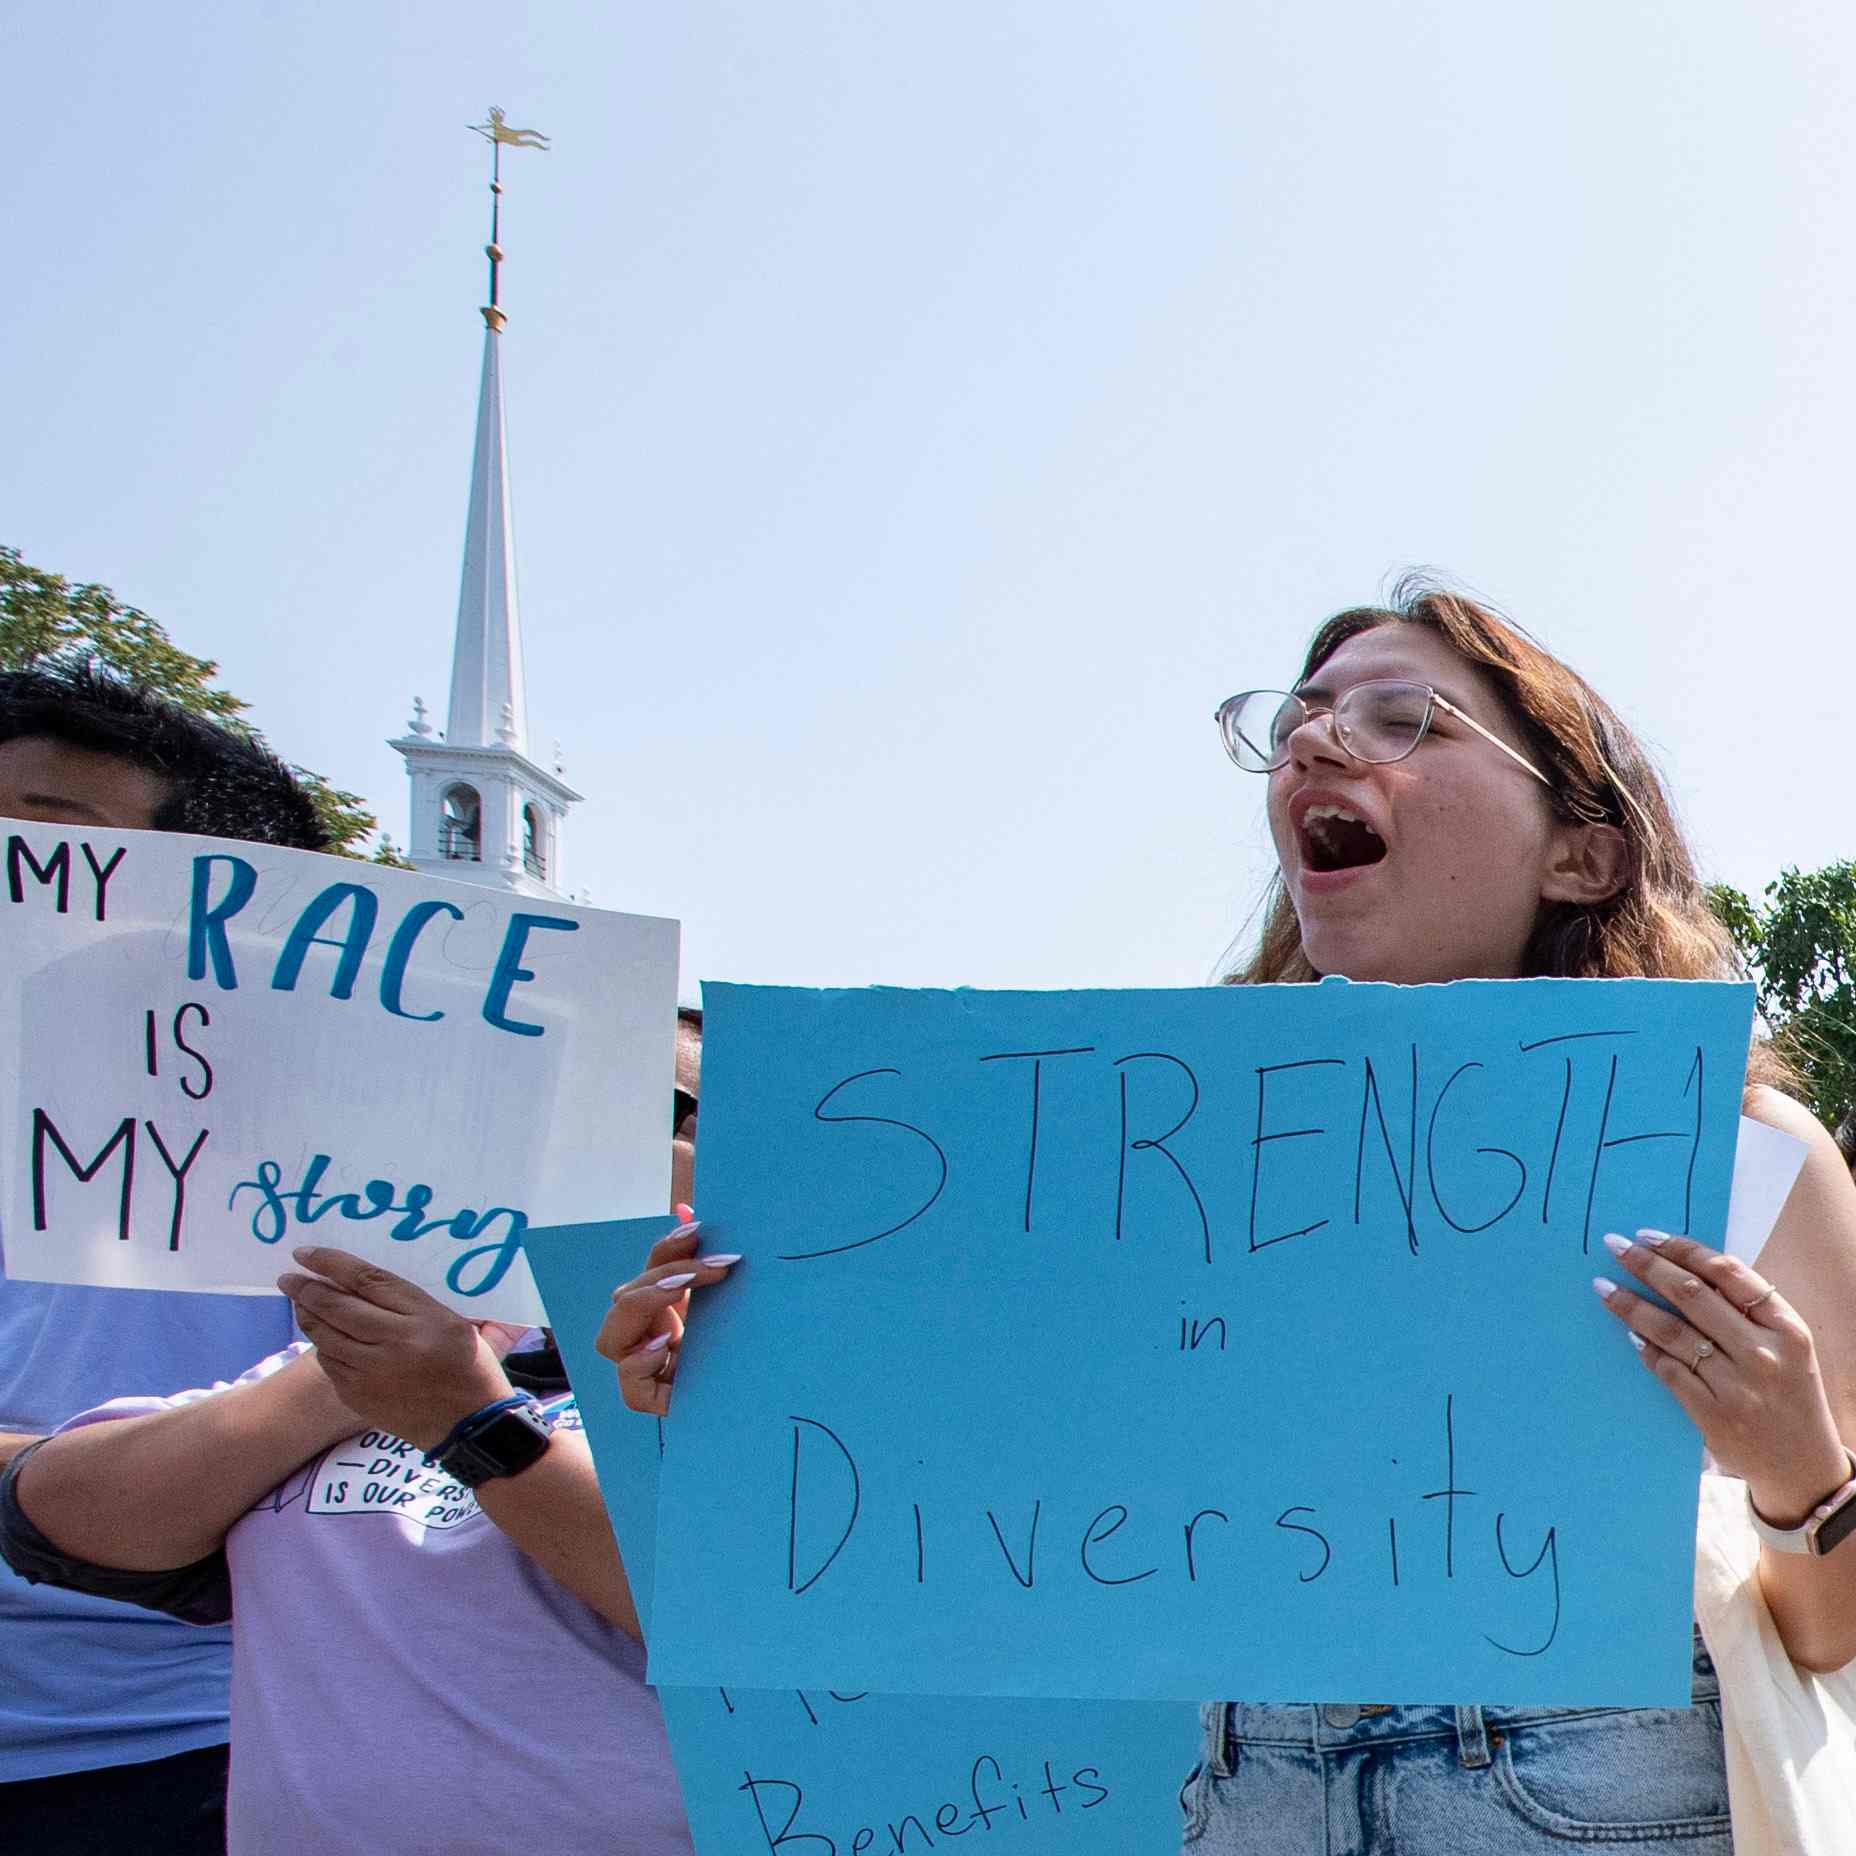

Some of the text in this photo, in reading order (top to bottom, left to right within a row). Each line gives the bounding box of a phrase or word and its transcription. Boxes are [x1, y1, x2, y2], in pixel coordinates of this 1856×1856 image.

[8, 835, 580, 1037] MY RACE
[145, 1002, 214, 1100] IS
[32, 1107, 530, 1298] MY story
[777, 1030, 1704, 1264] STRENGTH
[1179, 1302, 1227, 1352] in
[325, 1481, 349, 1504] IS
[362, 1482, 417, 1508] OUR
[359, 1431, 416, 1459] OUR
[788, 1394, 1561, 1657] Diversity
